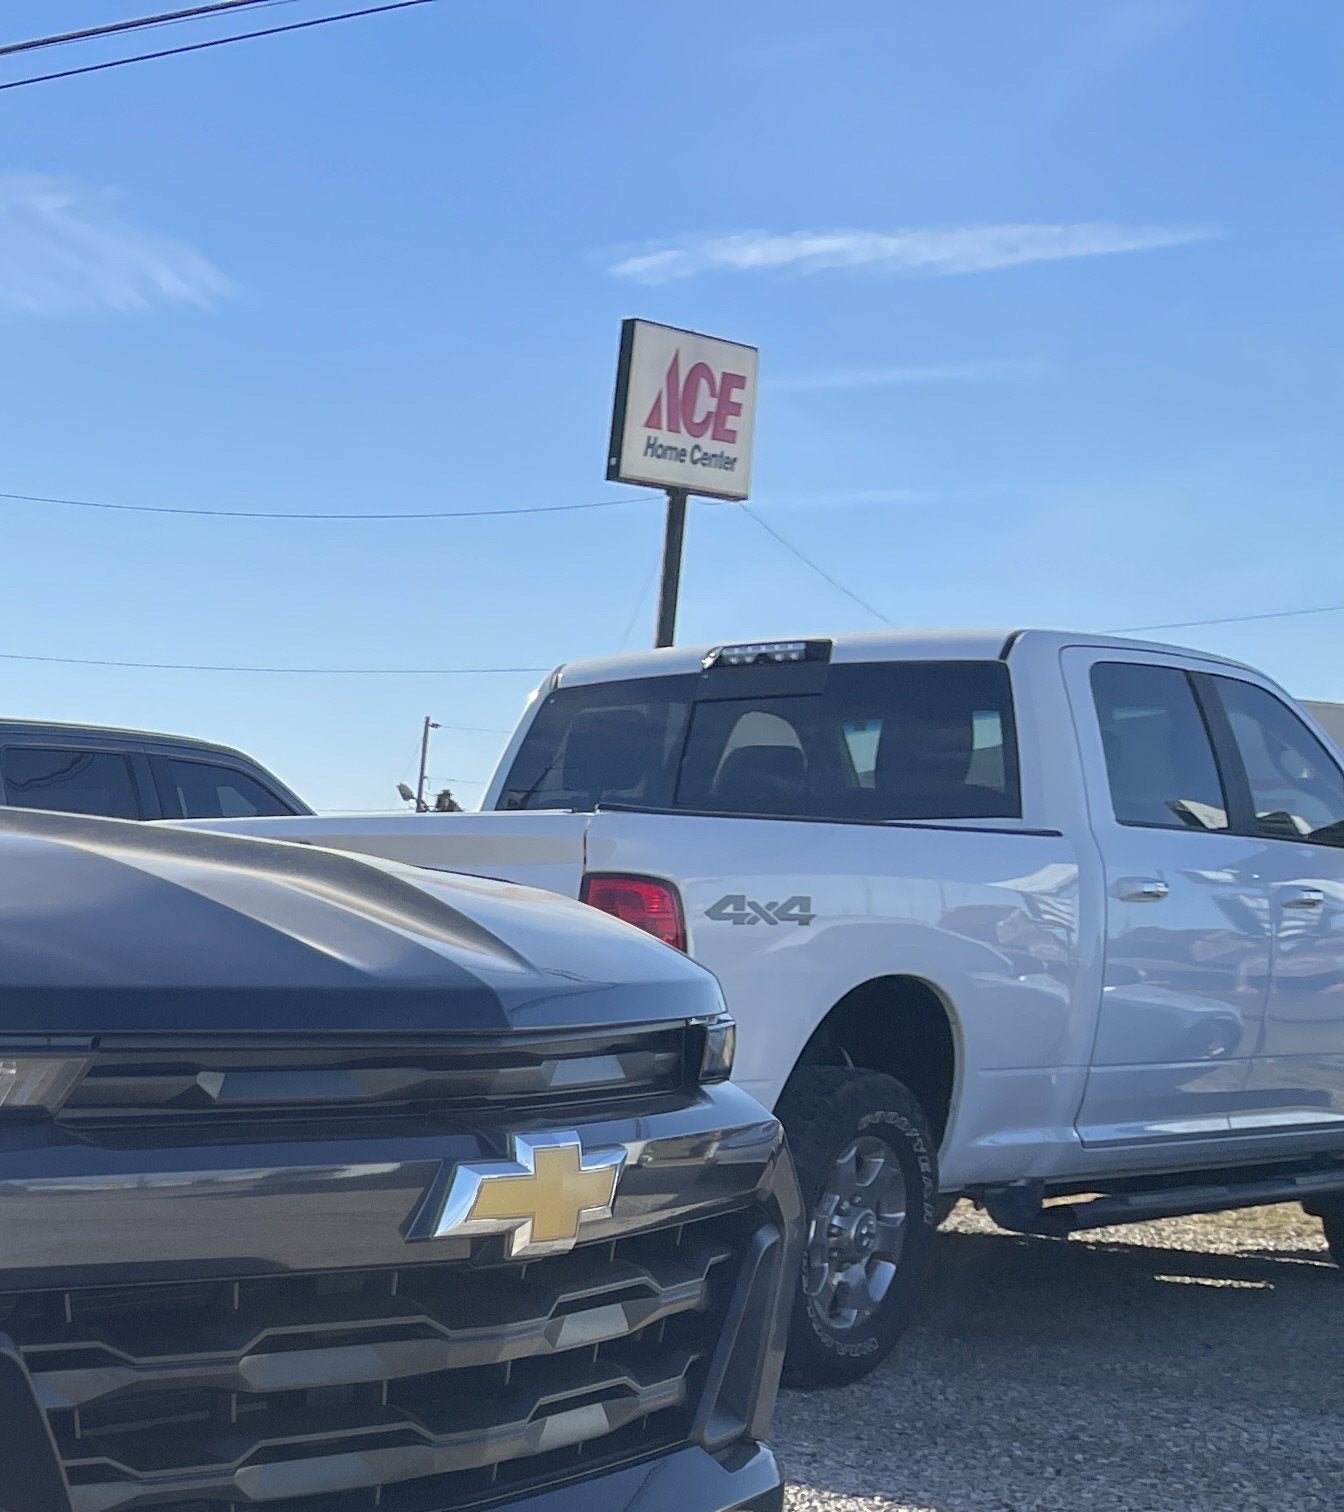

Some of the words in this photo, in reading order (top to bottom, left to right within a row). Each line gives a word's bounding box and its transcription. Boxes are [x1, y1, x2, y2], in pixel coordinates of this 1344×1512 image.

[643, 348, 746, 444] ACE
[643, 436, 687, 463] Home
[690, 444, 738, 472] Center
[704, 895, 817, 927] 4x4
